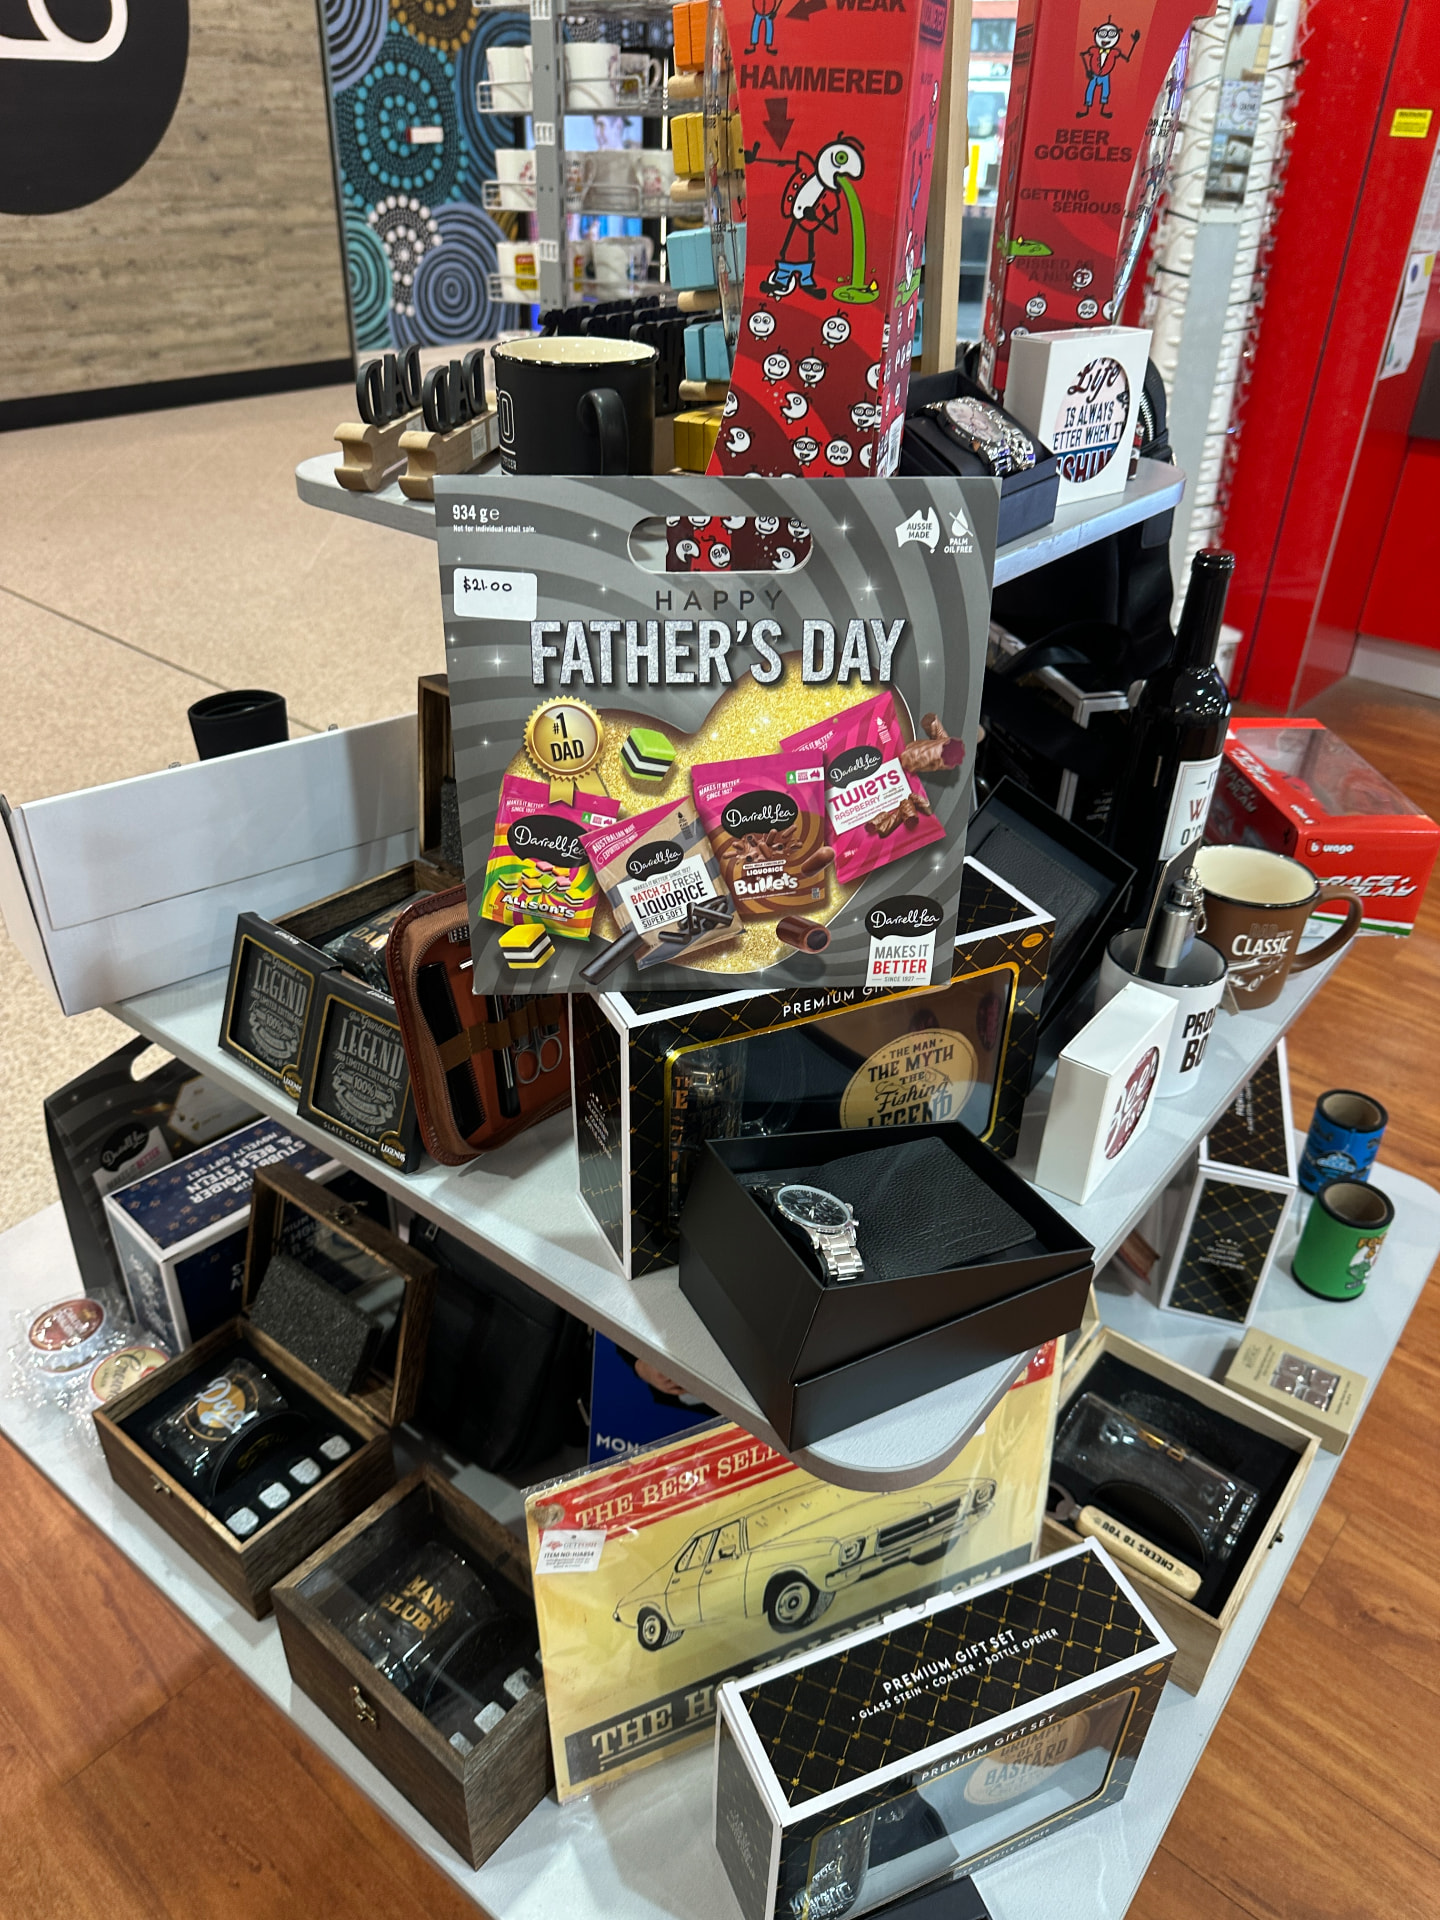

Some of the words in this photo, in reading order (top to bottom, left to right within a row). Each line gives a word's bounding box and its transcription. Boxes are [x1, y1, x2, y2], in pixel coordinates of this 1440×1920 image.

[740, 64, 903, 95] HAMMERED
[1055, 128, 1110, 146] BEER
[1034, 144, 1133, 162] GOGGLES
[1020, 188, 1090, 201] GETTING
[1052, 201, 1122, 215] SERIOUS
[1064, 407, 1076, 428] IS
[1077, 401, 1115, 426] ALWAYS
[1053, 428, 1082, 451] ETTER
[1085, 422, 1111, 445] WHEN
[452, 505, 476, 520] 934
[453, 525, 464, 533] Not
[464, 525, 474, 533] for
[475, 524, 504, 533] individual
[505, 525, 521, 533] retail
[906, 522, 933, 532] AUSSIE
[908, 531, 930, 539] MADE
[949, 538, 968, 546] PALM
[463, 576, 512, 593] $21.00
[655, 590, 783, 611] HAPPY
[530, 619, 783, 685] FATHER'S
[802, 619, 906, 685] DAY
[553, 712, 569, 739] #1
[551, 739, 585, 763] DAD
[830, 760, 864, 782] Darrell
[864, 754, 880, 770] Lea
[699, 784, 716, 796] MAKES
[706, 791, 721, 801] SINCE
[828, 769, 901, 812] TWISTS
[506, 798, 521, 808] MAKES
[726, 805, 774, 827] Darrell
[771, 803, 795, 824] Lea
[835, 795, 881, 822] RASPBERRY
[514, 825, 568, 852] Darrell
[566, 835, 588, 860] Lea
[591, 829, 625, 854] AUSTRALIAN
[630, 855, 666, 875] Darrell
[664, 849, 681, 865] Lea
[746, 866, 784, 876] LIQUORICE
[630, 887, 660, 905] BATCH
[660, 882, 671, 894] 37
[672, 872, 701, 890] FRESH
[634, 882, 708, 919] LIQUORICE
[1350, 886, 1417, 897] PLAY
[502, 894, 576, 919] ALLSORTS
[642, 914, 666, 929] SUPER
[666, 908, 683, 921] SOFT
[870, 909, 919, 928] Darrell
[914, 908, 940, 928] Lea
[350, 927, 389, 948] DAD
[1231, 934, 1292, 956] CLASSIC
[875, 945, 916, 959] MAKES
[919, 944, 929, 957] IT
[873, 959, 927, 975] BETTER
[253, 958, 308, 1018] LEGEND
[783, 989, 855, 1018] PREMIUM
[360, 1014, 391, 1037] Grandad
[338, 1018, 405, 1080] LEGEND
[890, 1046, 910, 1059] THE
[913, 1039, 936, 1053] MAN
[345, 1056, 368, 1075] LIMITED
[368, 1068, 389, 1087] EDITION
[868, 1060, 900, 1083] THE
[905, 1044, 954, 1073] MYTH
[354, 1076, 375, 1097] 100%
[674, 1076, 694, 1088] TH
[899, 1071, 925, 1085] THE
[874, 1081, 949, 1113] Fishing
[230, 1131, 278, 1160] NOVELTY
[323, 1121, 344, 1137] SLATE
[345, 1133, 377, 1154] COASTER
[207, 1155, 231, 1172] GIFT
[235, 1143, 276, 1168] BEER
[185, 1167, 206, 1182] SET
[575, 1492, 634, 1530] THE
[641, 1464, 710, 1508] BEST
[1101, 1521, 1121, 1538] YOU
[1122, 1535, 1136, 1549] TO
[1137, 1544, 1174, 1572] CHEERS
[381, 1592, 432, 1632] CLUB
[859, 1699, 892, 1719] GLASS
[893, 1686, 923, 1704] STEIN
[932, 1664, 976, 1687] COASTER
[984, 1645, 1021, 1666] BOTTLE
[1021, 1628, 1059, 1649] OPENER
[883, 1657, 951, 1695] PREMIUM
[955, 1641, 987, 1664] GIFT
[989, 1630, 1016, 1650] SET
[592, 1702, 673, 1760] THE
[921, 1744, 988, 1781] PREMIUM
[995, 1727, 1028, 1746] GIFT
[1029, 1713, 1057, 1731] SET
[985, 1738, 1068, 1786] BASTARD
